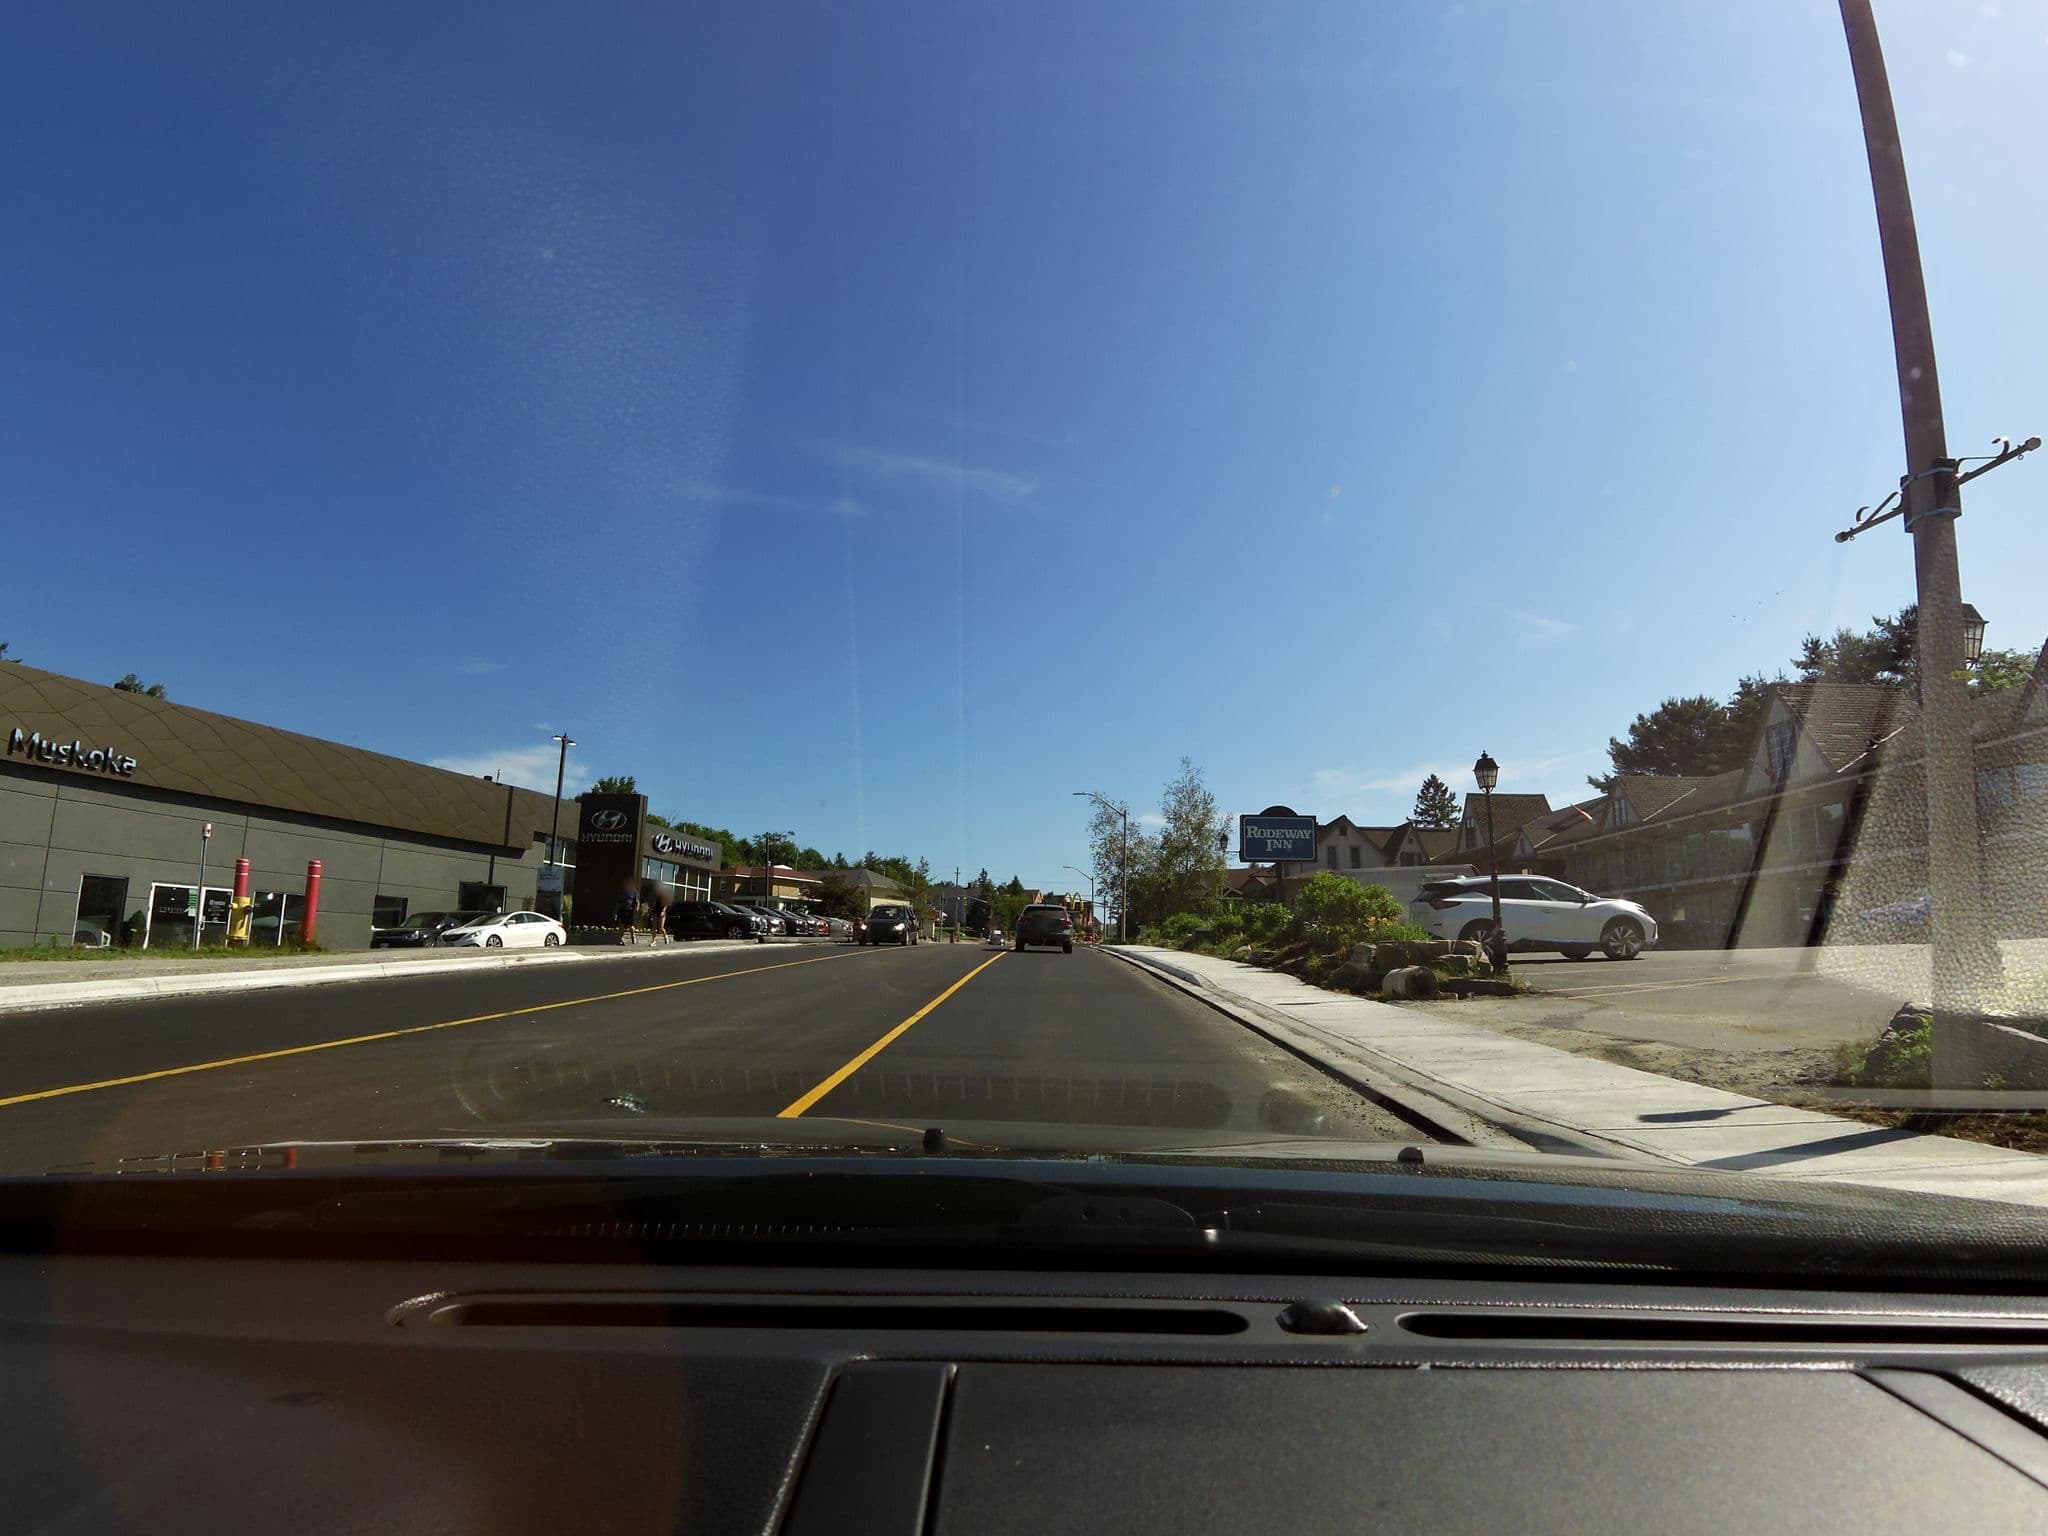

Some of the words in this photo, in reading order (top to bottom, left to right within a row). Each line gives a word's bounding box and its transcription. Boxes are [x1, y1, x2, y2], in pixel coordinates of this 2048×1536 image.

[7, 728, 136, 777] Muskoka
[581, 833, 633, 843] HYUNDAI
[1245, 826, 1312, 840] RODEWAY
[674, 839, 713, 858] HYUNDAI
[1265, 839, 1293, 852] INN
